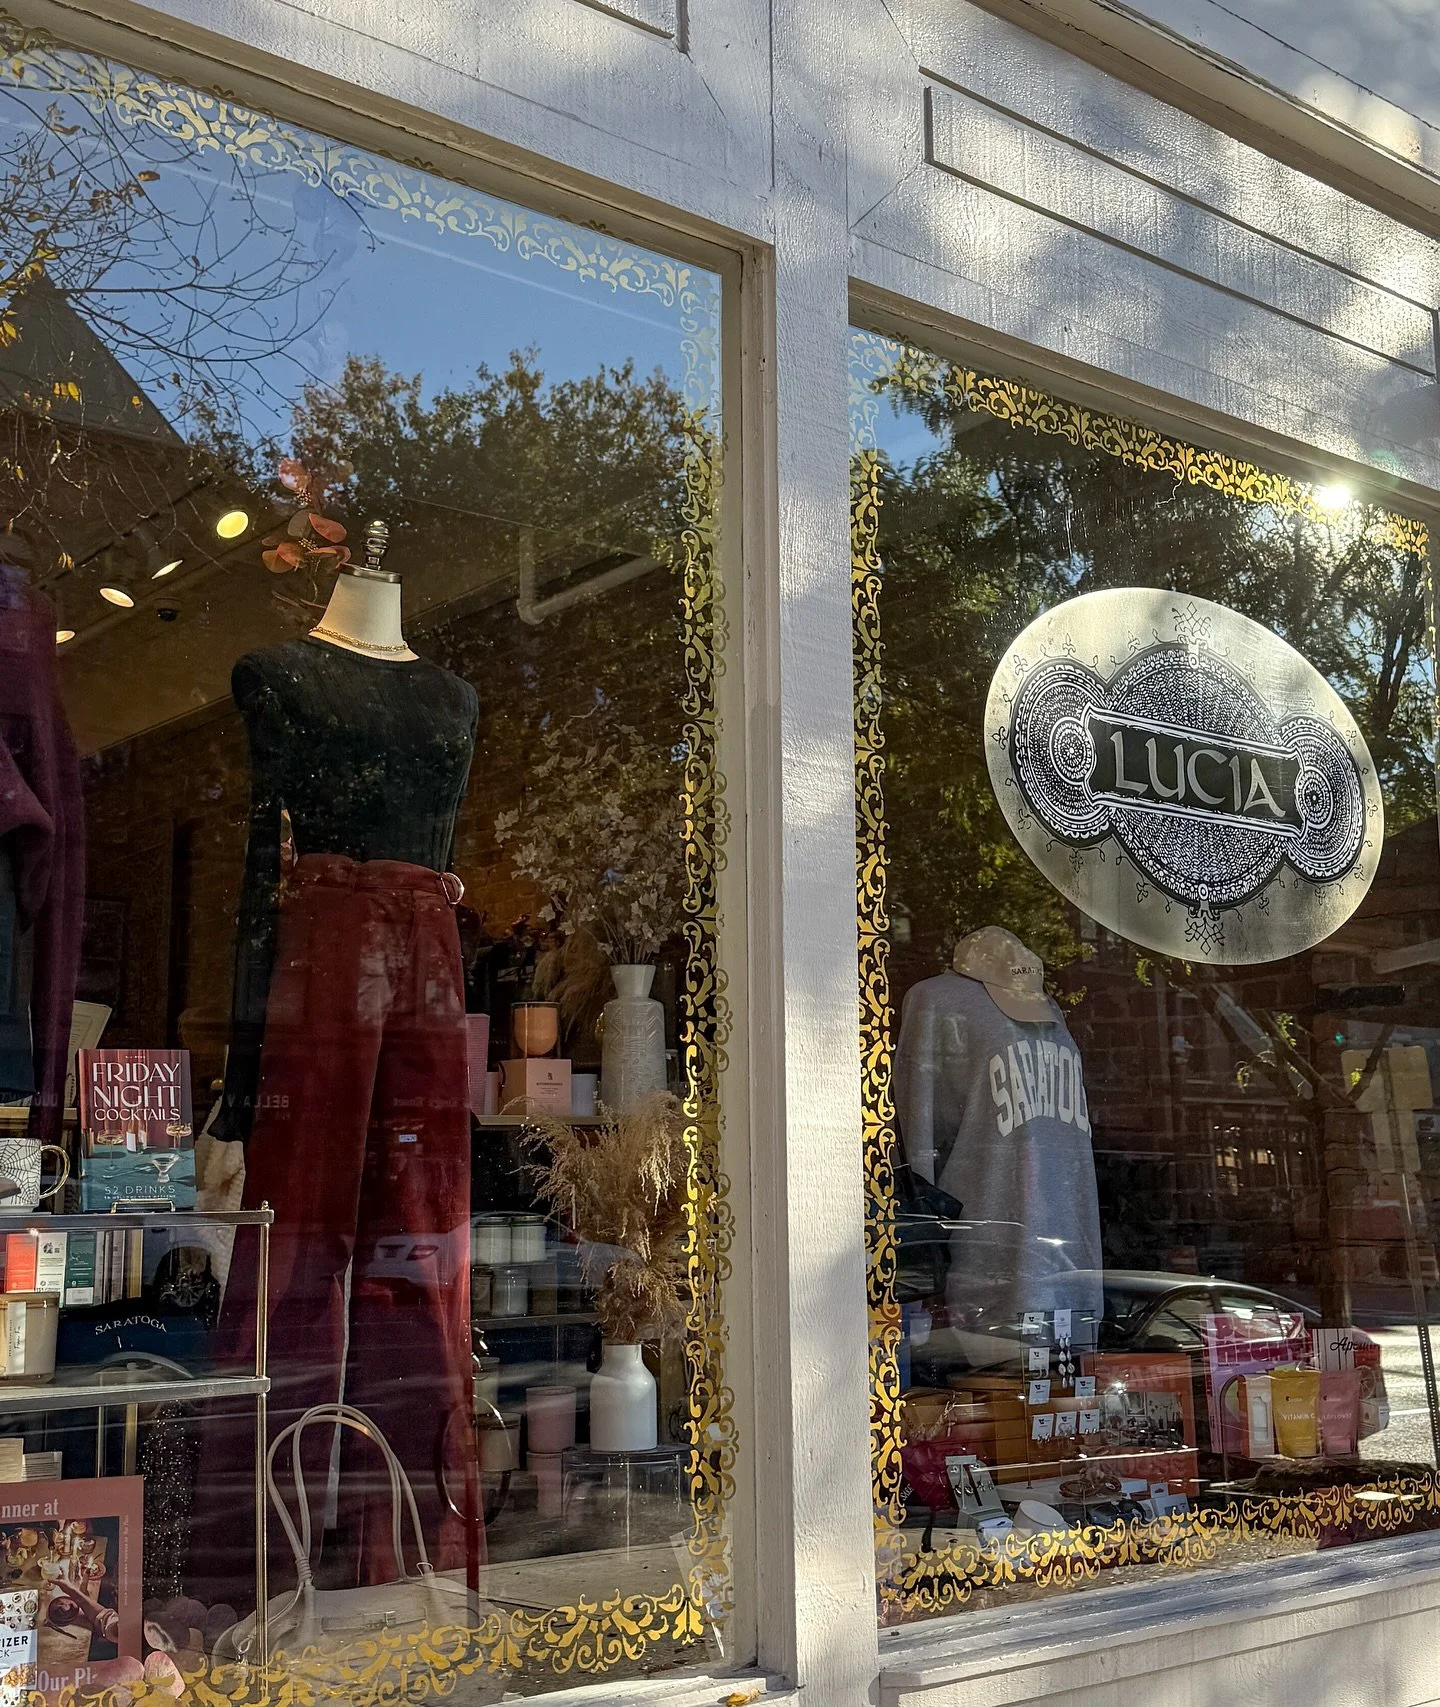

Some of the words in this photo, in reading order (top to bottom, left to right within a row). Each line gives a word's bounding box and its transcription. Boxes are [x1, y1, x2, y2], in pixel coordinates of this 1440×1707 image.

[1110, 731, 1286, 818] LUCIA
[92, 1062, 180, 1082] FRIDAY
[93, 1085, 181, 1108] NIGHT
[94, 1108, 181, 1121] COCKTAILS
[104, 1185, 119, 1195] 52
[125, 1184, 176, 1195] DRINKS
[95, 1315, 168, 1335] SARATOGA
[43, 1498, 59, 1516] at
[0, 1635, 29, 1648] IZER
[38, 1670, 69, 1692] Our
